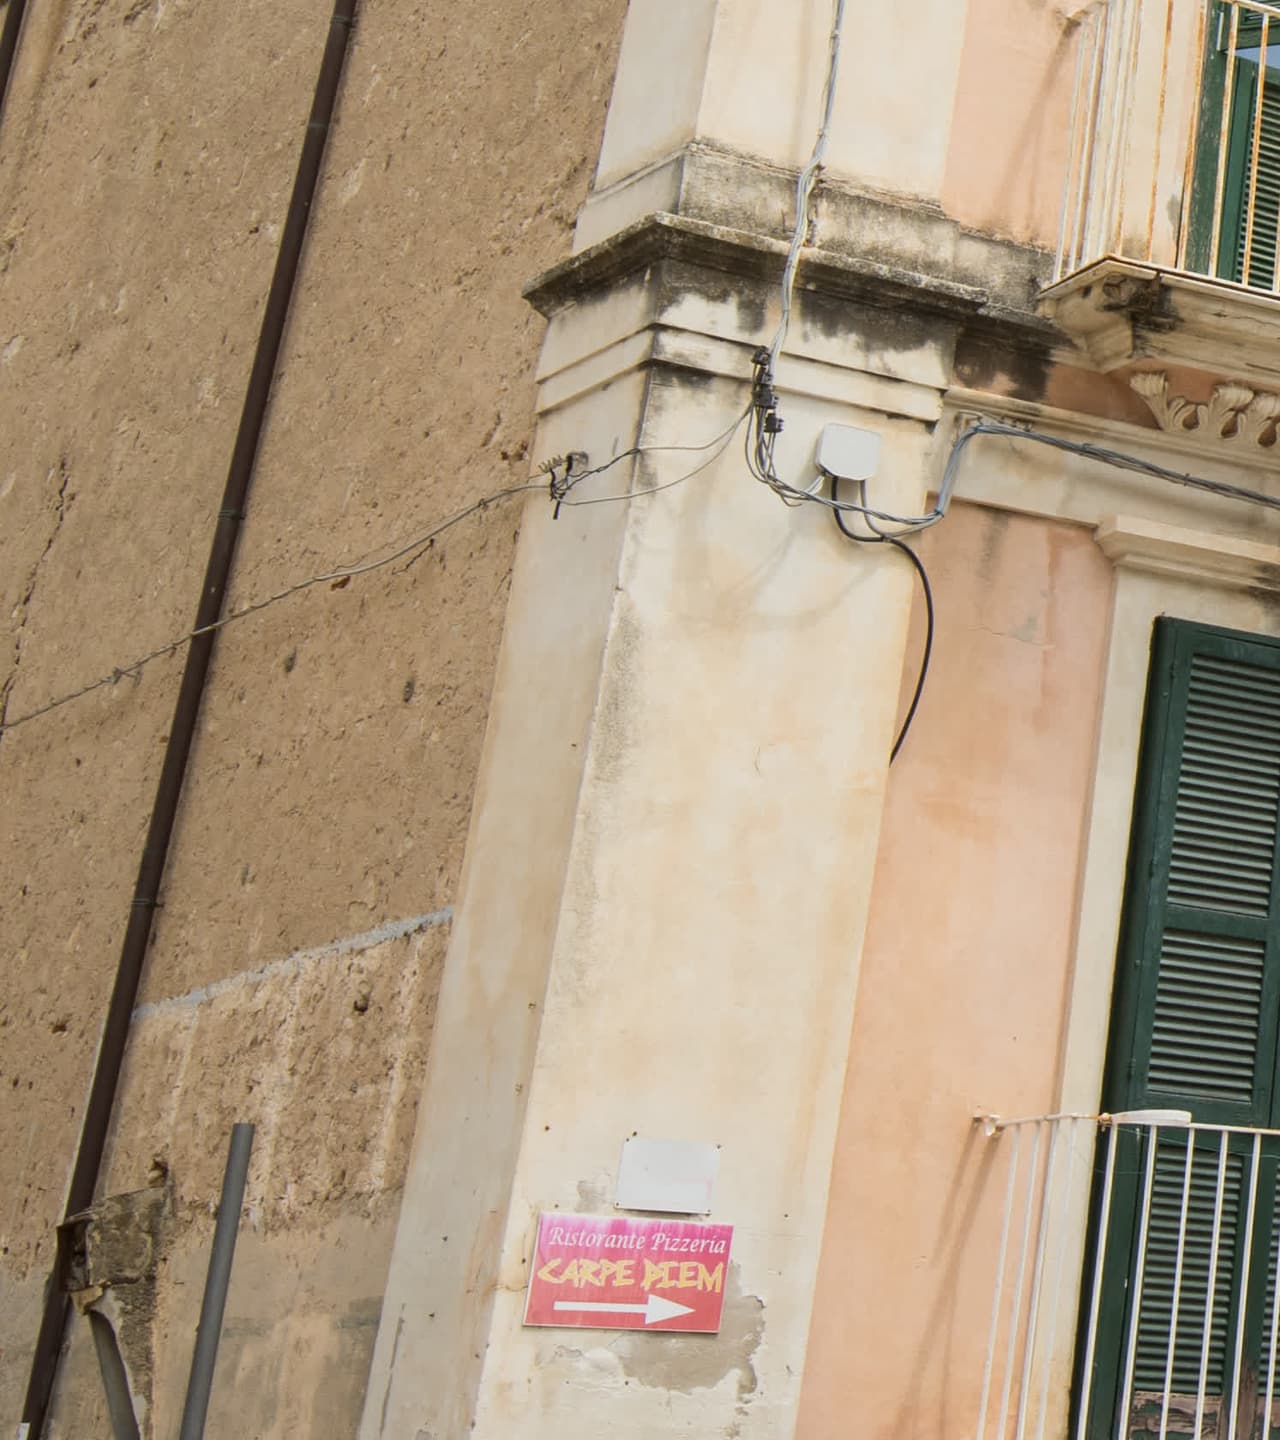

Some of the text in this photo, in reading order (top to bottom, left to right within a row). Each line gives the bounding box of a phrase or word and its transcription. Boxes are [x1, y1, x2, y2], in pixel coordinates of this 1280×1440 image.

[549, 1226, 727, 1254] Ristorante Pizzeria
[537, 1257, 724, 1294] CARPE DIEM
